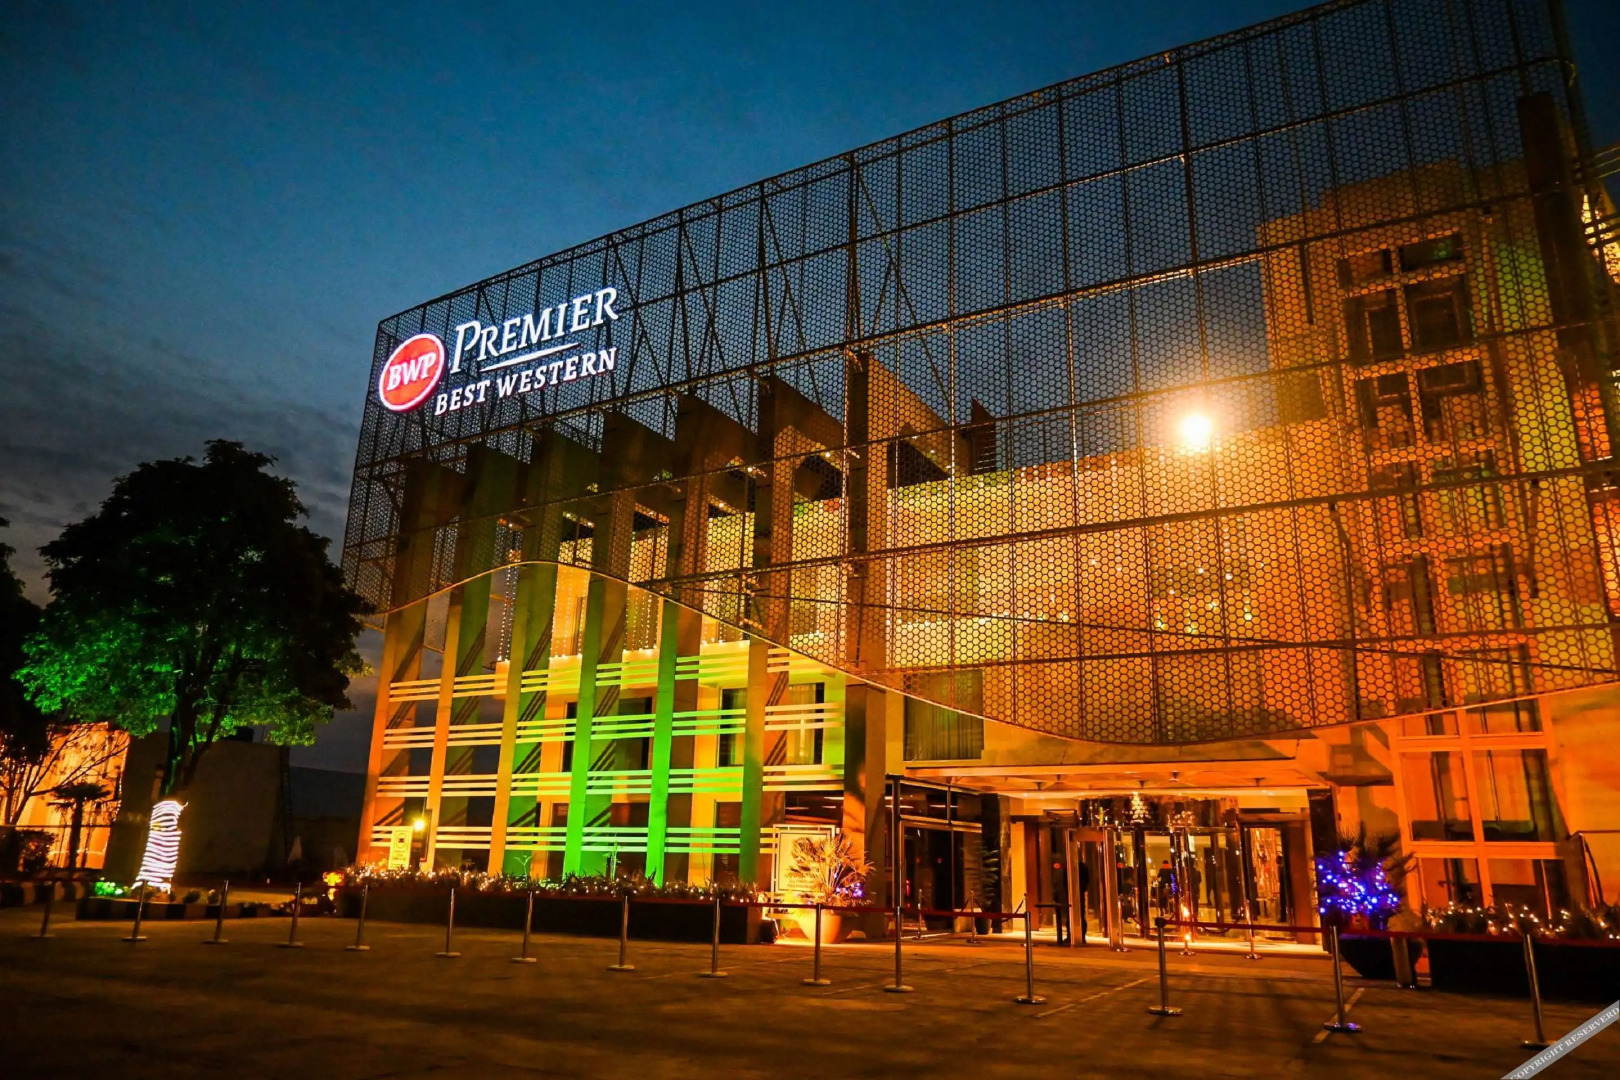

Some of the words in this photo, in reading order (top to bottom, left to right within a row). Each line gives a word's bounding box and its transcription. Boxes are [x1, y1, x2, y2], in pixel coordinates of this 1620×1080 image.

[450, 287, 619, 374] PREMIER
[386, 352, 437, 391] BWP
[435, 380, 491, 415] BEST
[496, 347, 617, 398] WESTERN
